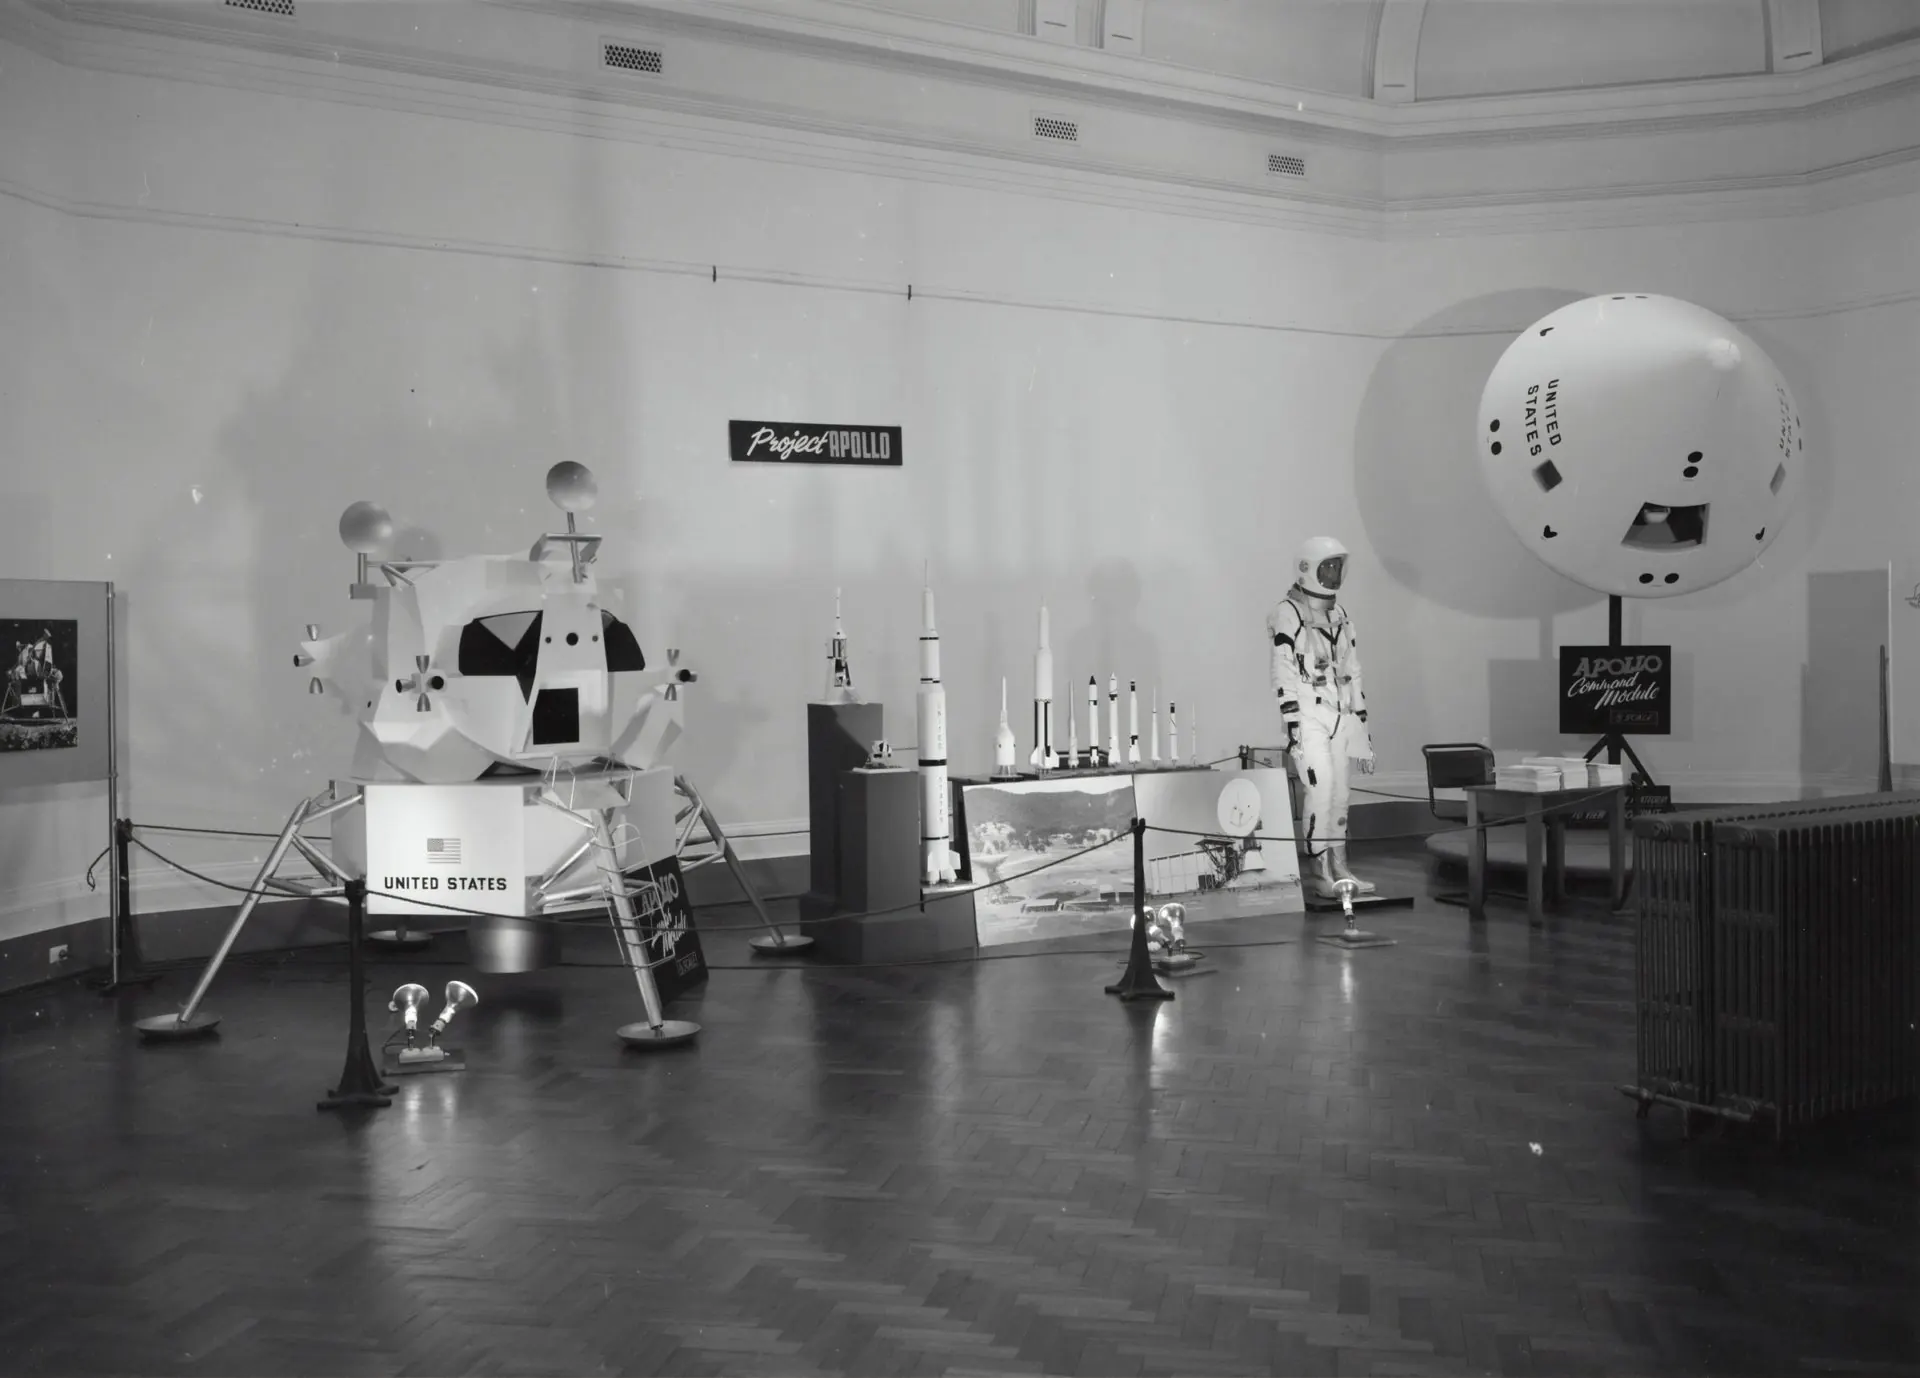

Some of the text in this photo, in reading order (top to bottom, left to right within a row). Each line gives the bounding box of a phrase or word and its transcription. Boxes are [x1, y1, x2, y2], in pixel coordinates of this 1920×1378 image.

[1525, 384, 1542, 456] STATES
[1545, 379, 1562, 446] UNITED
[746, 426, 891, 460] Project APOLLO
[1572, 655, 1663, 678] APOLLO
[1567, 671, 1640, 698] Command
[1594, 681, 1660, 710] Module
[384, 876, 508, 891] UNITED STATES
